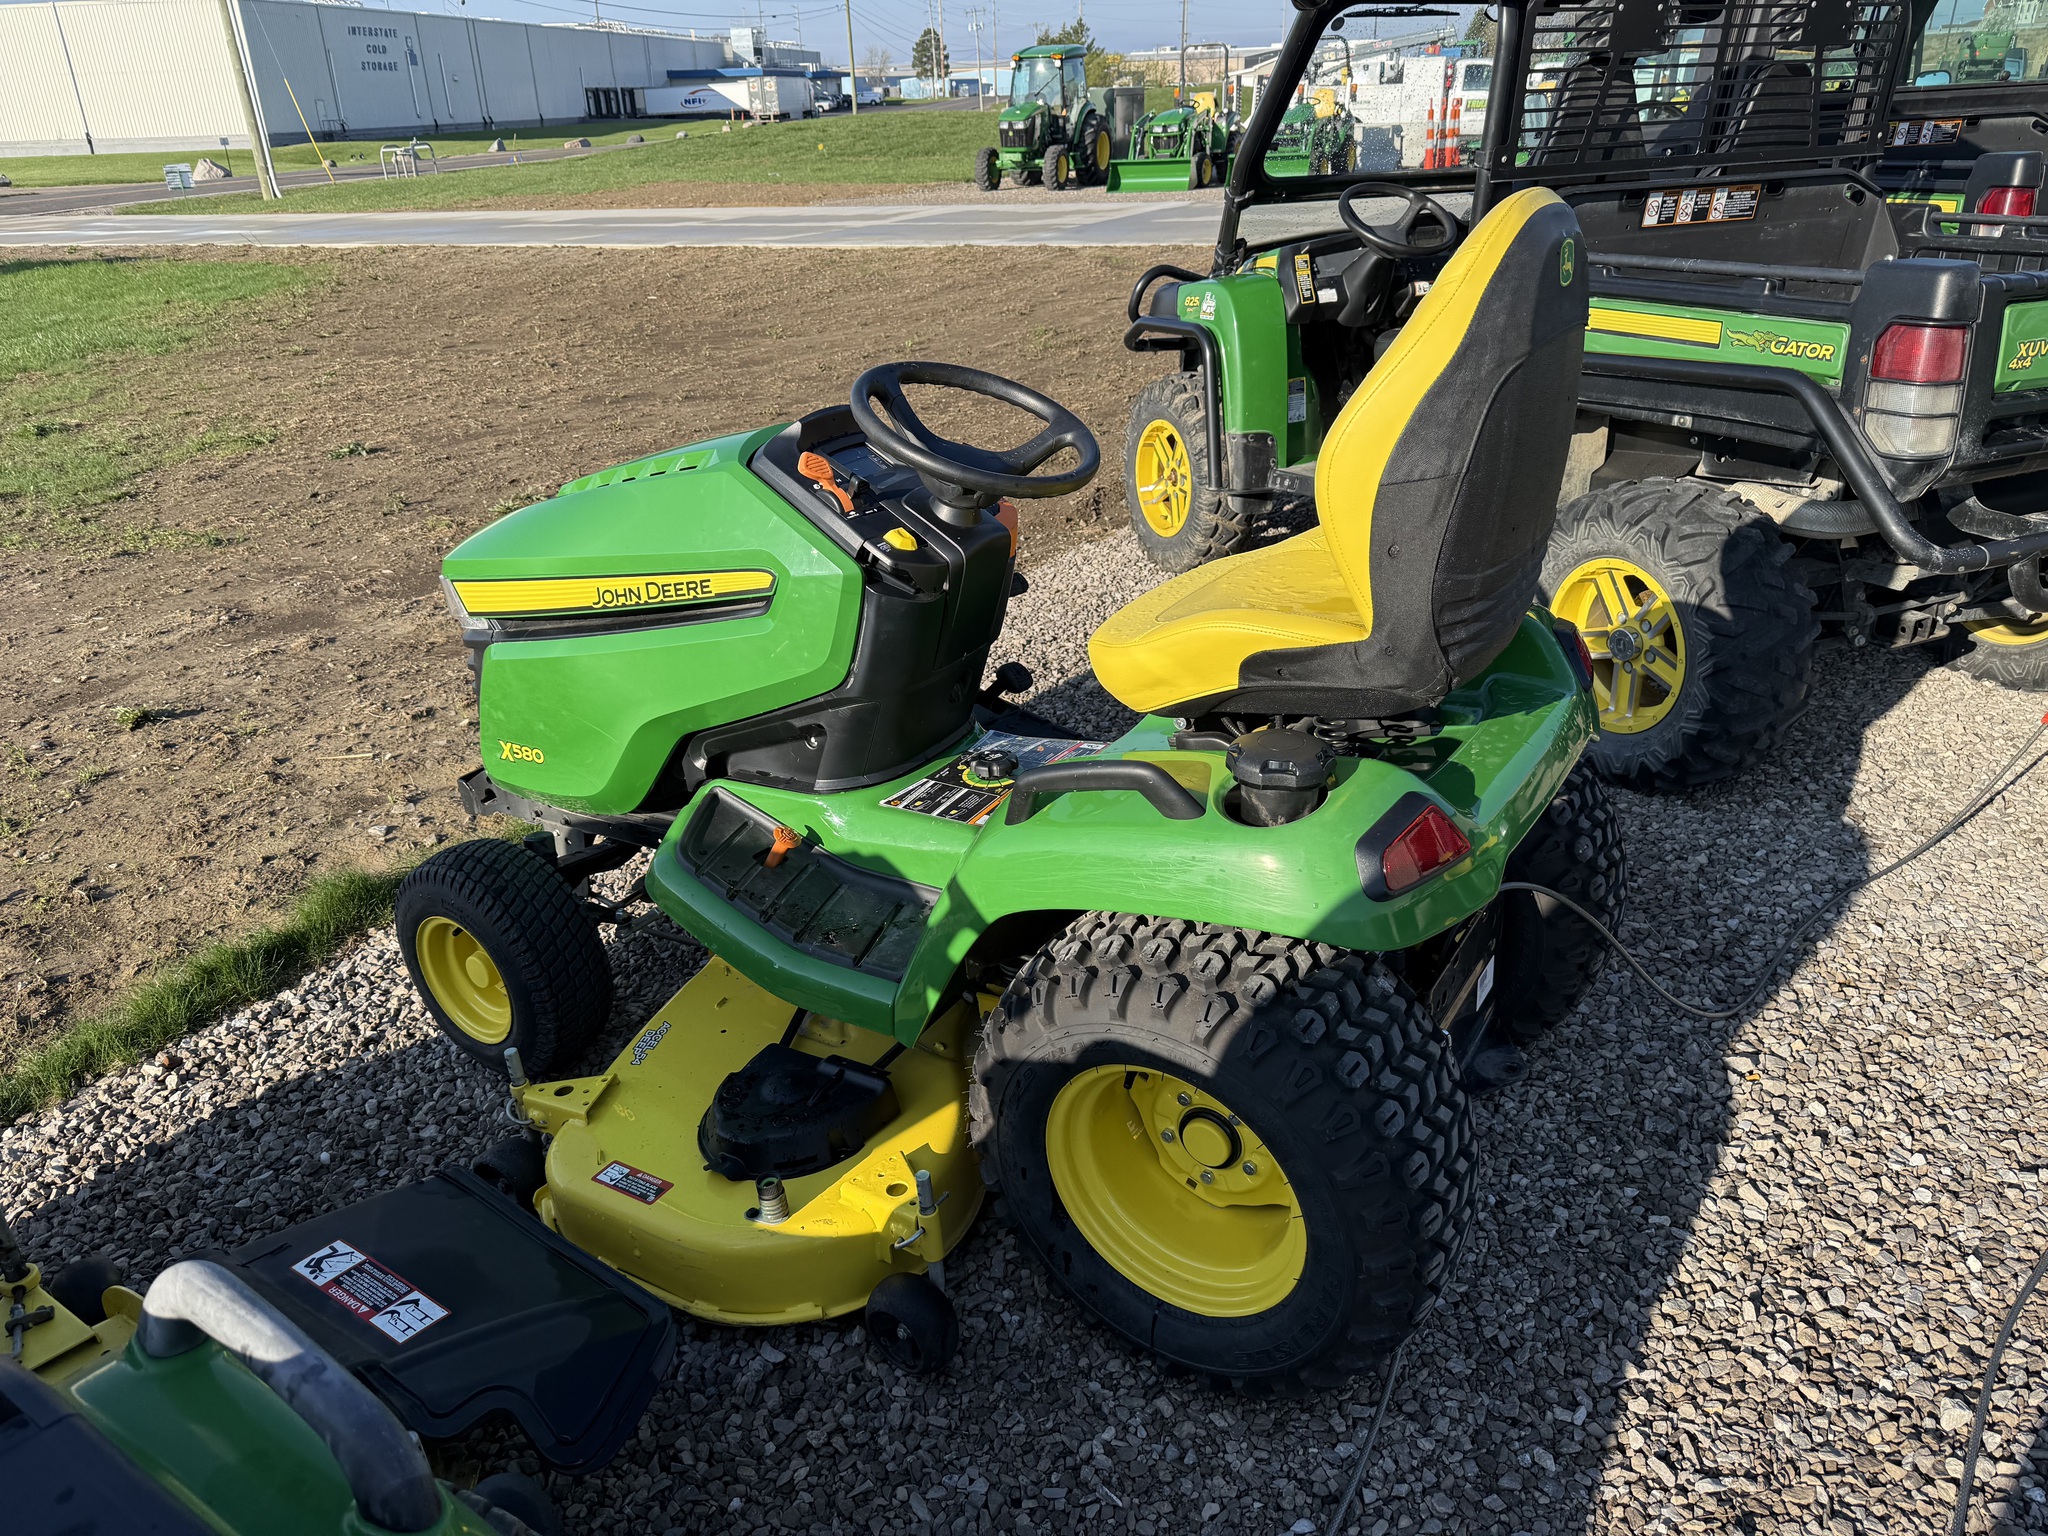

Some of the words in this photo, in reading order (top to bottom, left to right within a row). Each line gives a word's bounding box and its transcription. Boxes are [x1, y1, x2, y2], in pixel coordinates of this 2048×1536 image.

[347, 26, 398, 38] INTERSTATE
[366, 44, 387, 54] COLD
[361, 61, 398, 71] STORAGE
[1770, 336, 1835, 361] GATOR
[2008, 357, 2032, 369] 4x4
[592, 586, 642, 606] JOHN
[645, 579, 713, 601] DEERE
[498, 740, 545, 764] X580
[633, 1030, 656, 1055] DEEP
[643, 1021, 671, 1052] ACCEL
[640, 1173, 662, 1184] DANGER
[327, 1285, 361, 1309] DANGER
